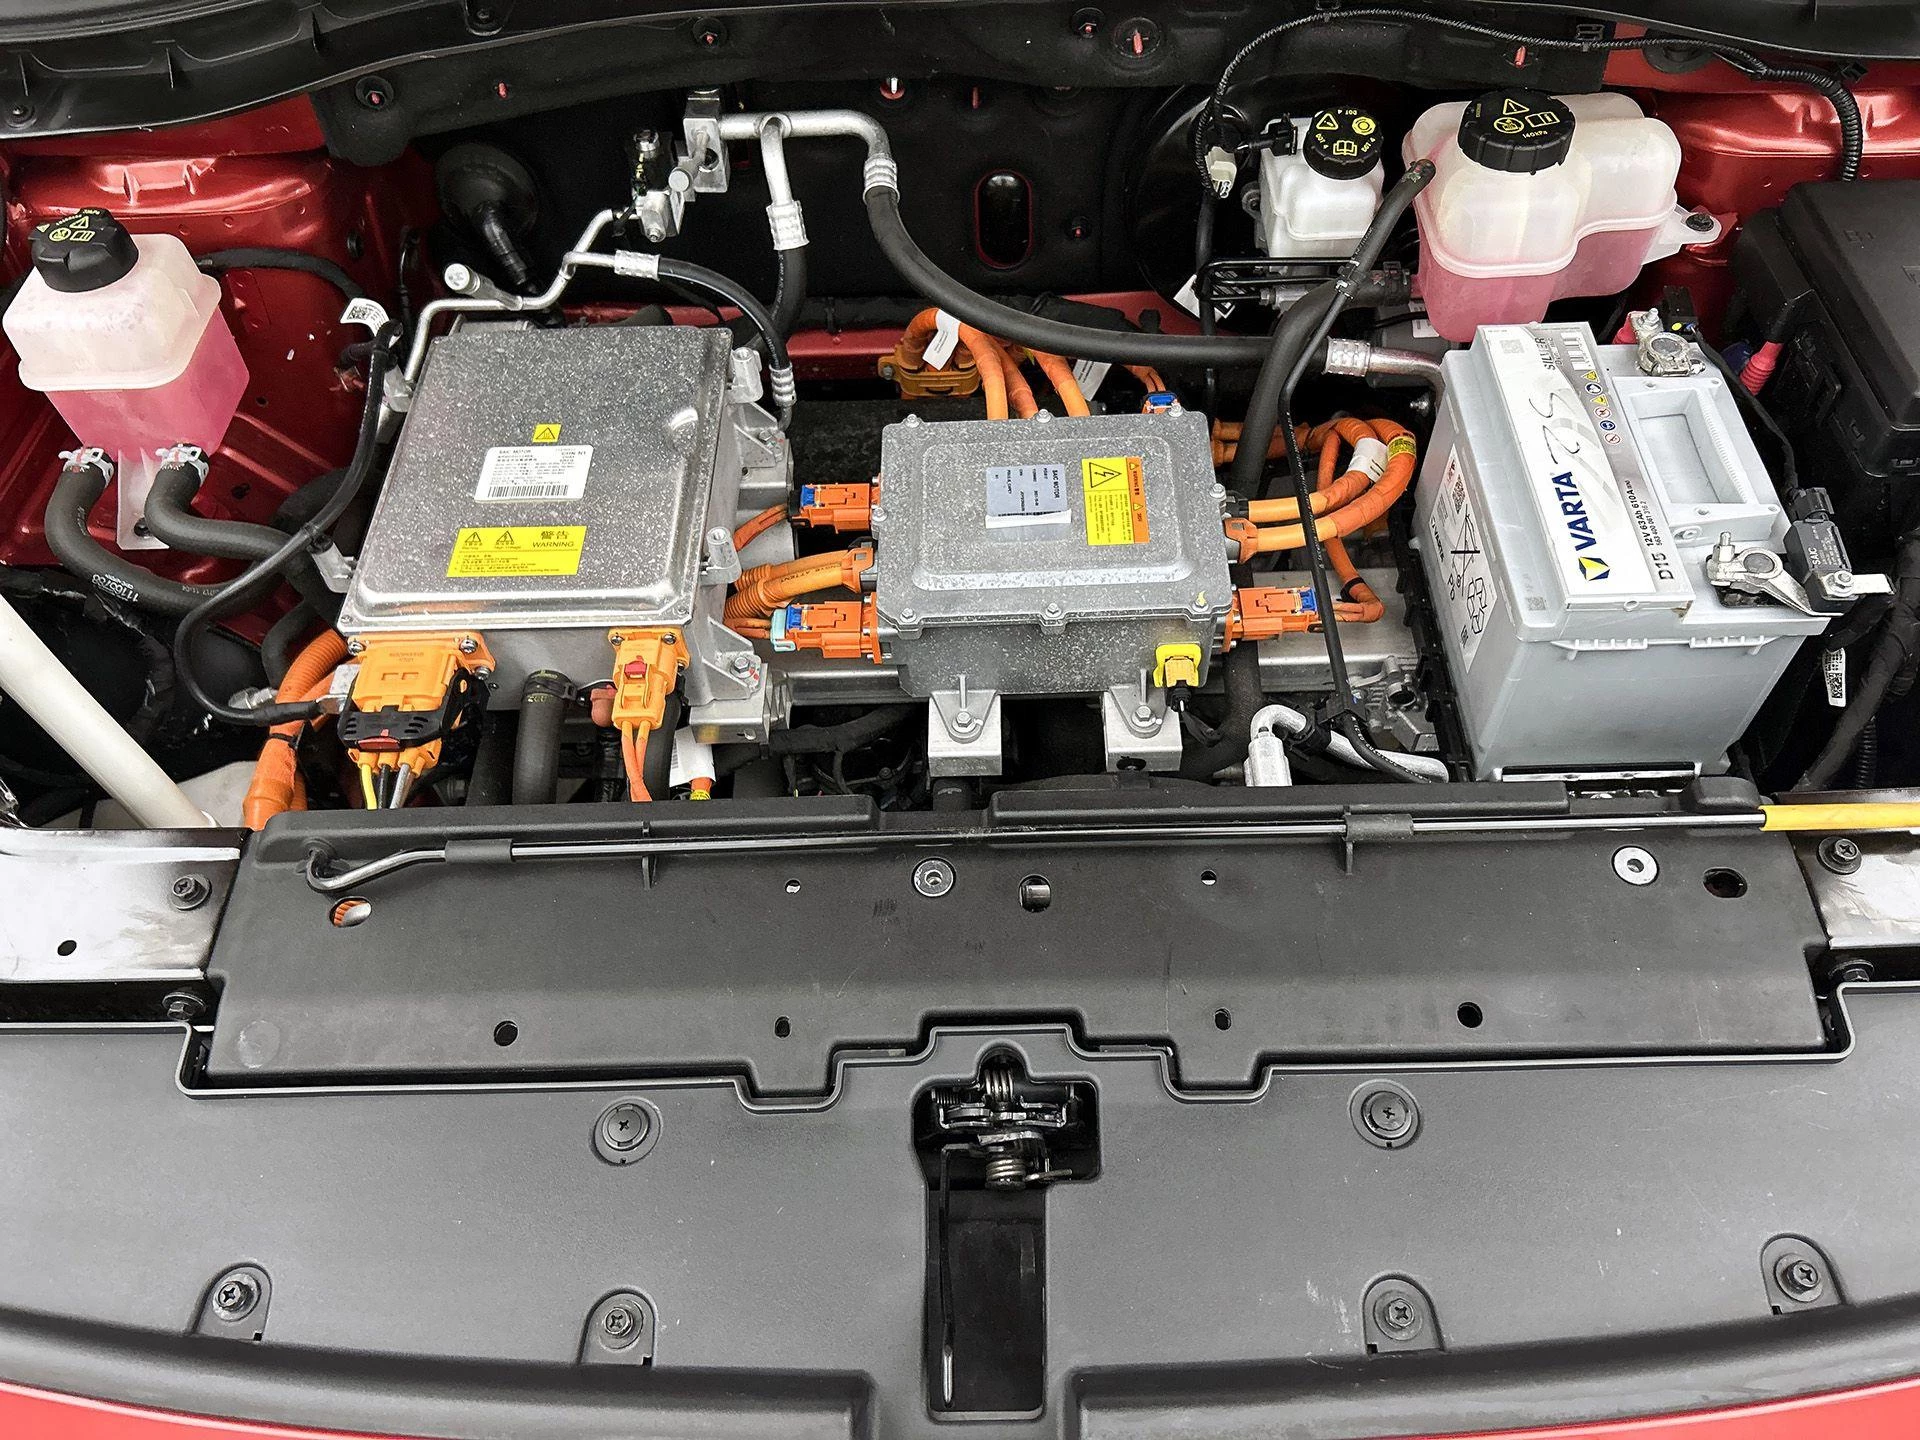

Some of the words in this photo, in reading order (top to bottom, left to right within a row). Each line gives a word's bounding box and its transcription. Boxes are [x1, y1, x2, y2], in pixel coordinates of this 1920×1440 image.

[1626, 489, 1640, 509] 610A
[1551, 471, 1597, 551] VARTA
[1634, 510, 1648, 530] 63Ah
[540, 530, 569, 540] 警告
[1641, 532, 1654, 547] 12V
[532, 541, 575, 549] WARNING
[1651, 552, 1674, 580] D15
[1807, 547, 1821, 566] SAIC
